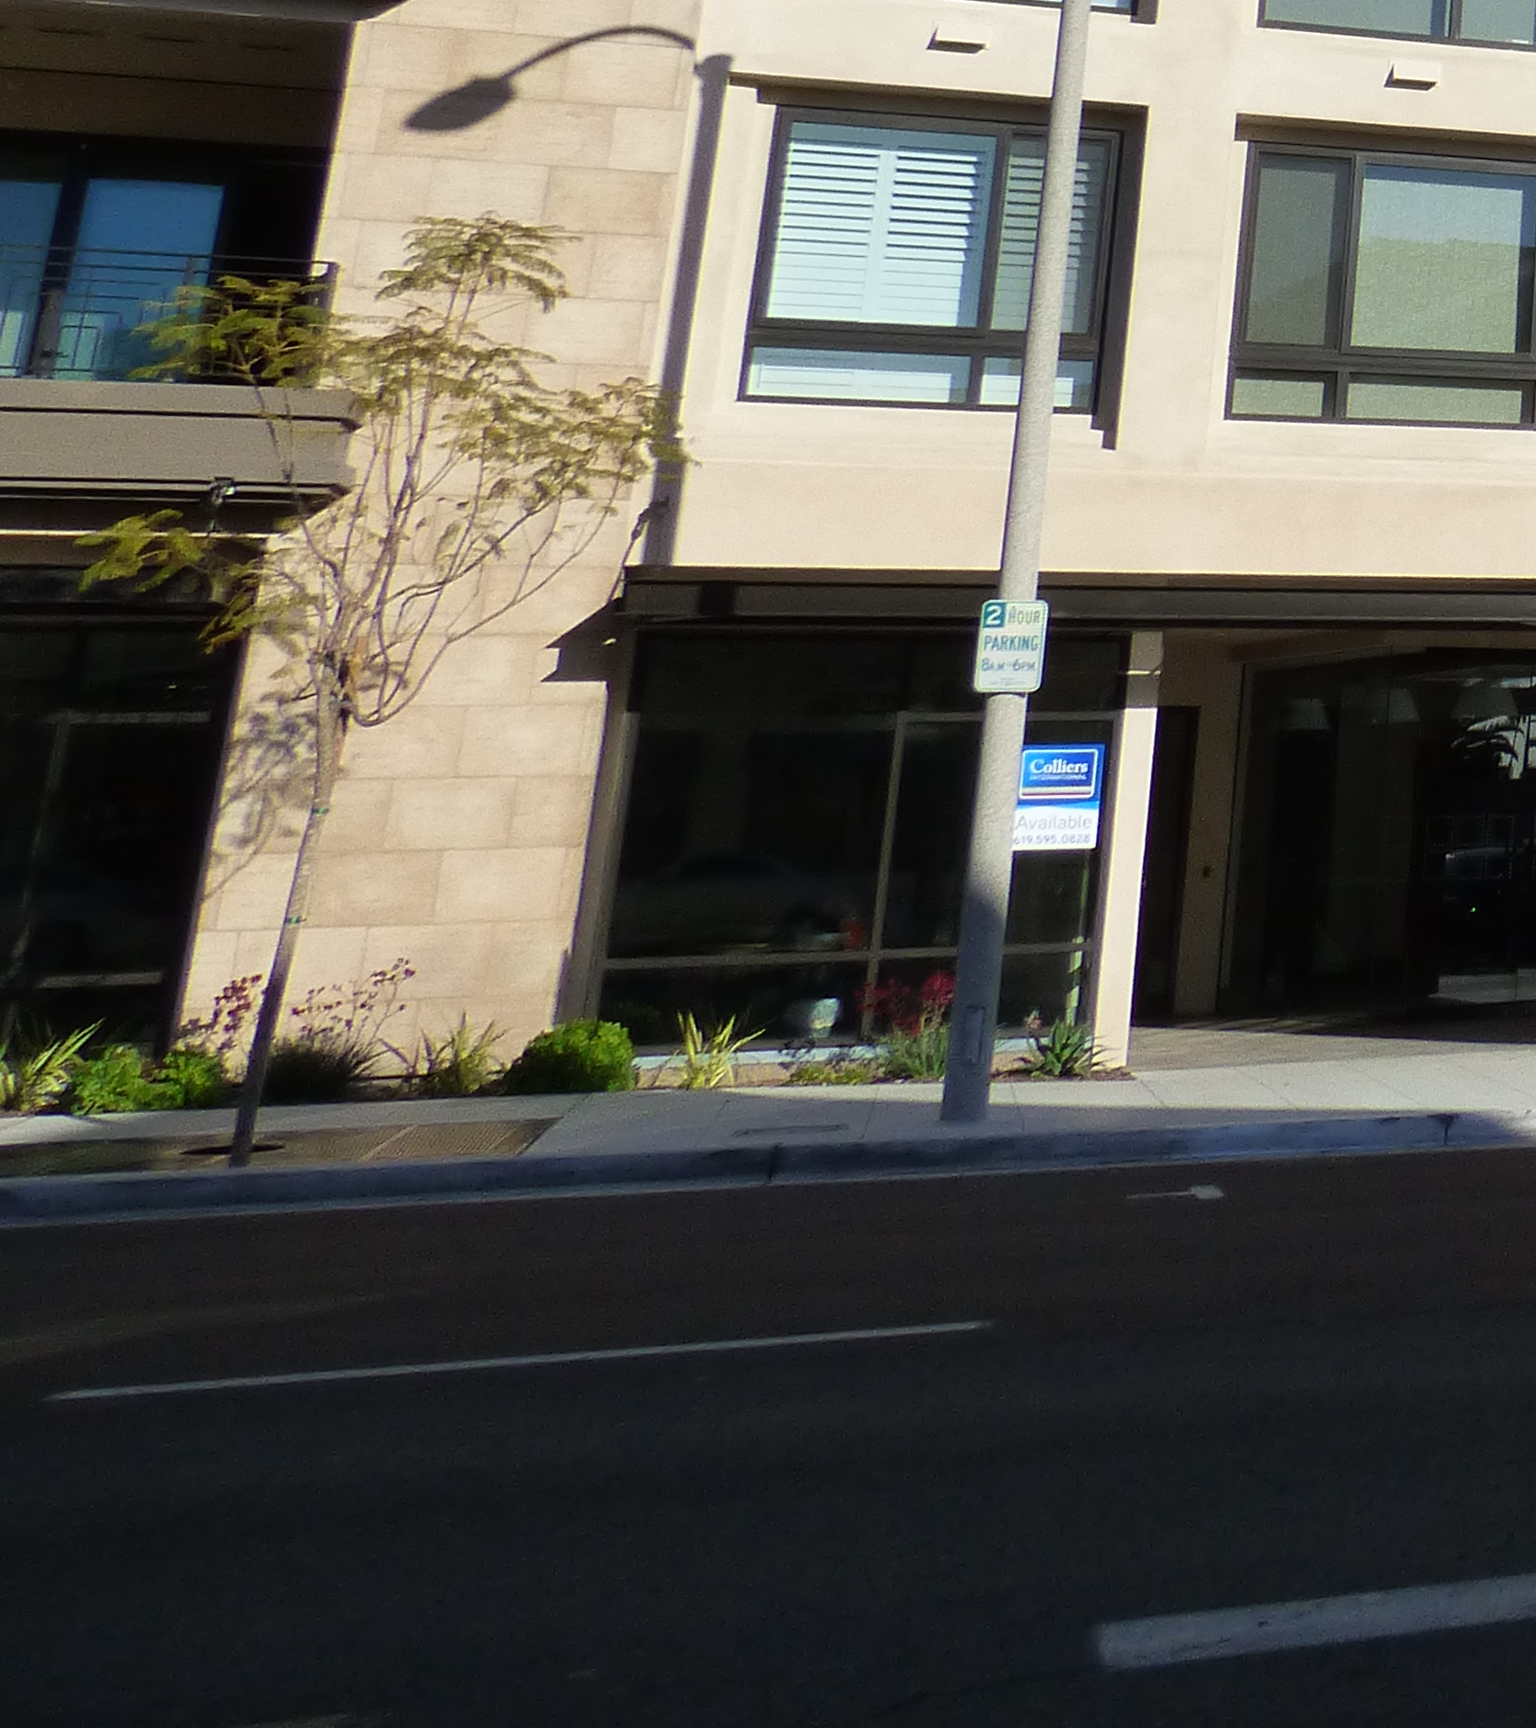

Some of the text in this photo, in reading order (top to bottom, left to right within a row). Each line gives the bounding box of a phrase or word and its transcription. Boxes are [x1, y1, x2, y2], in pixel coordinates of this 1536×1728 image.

[986, 605, 1041, 625] 2 HOUR
[984, 635, 1039, 651] PARKING
[1030, 758, 1089, 774] Colliers
[1015, 814, 1092, 830] Available
